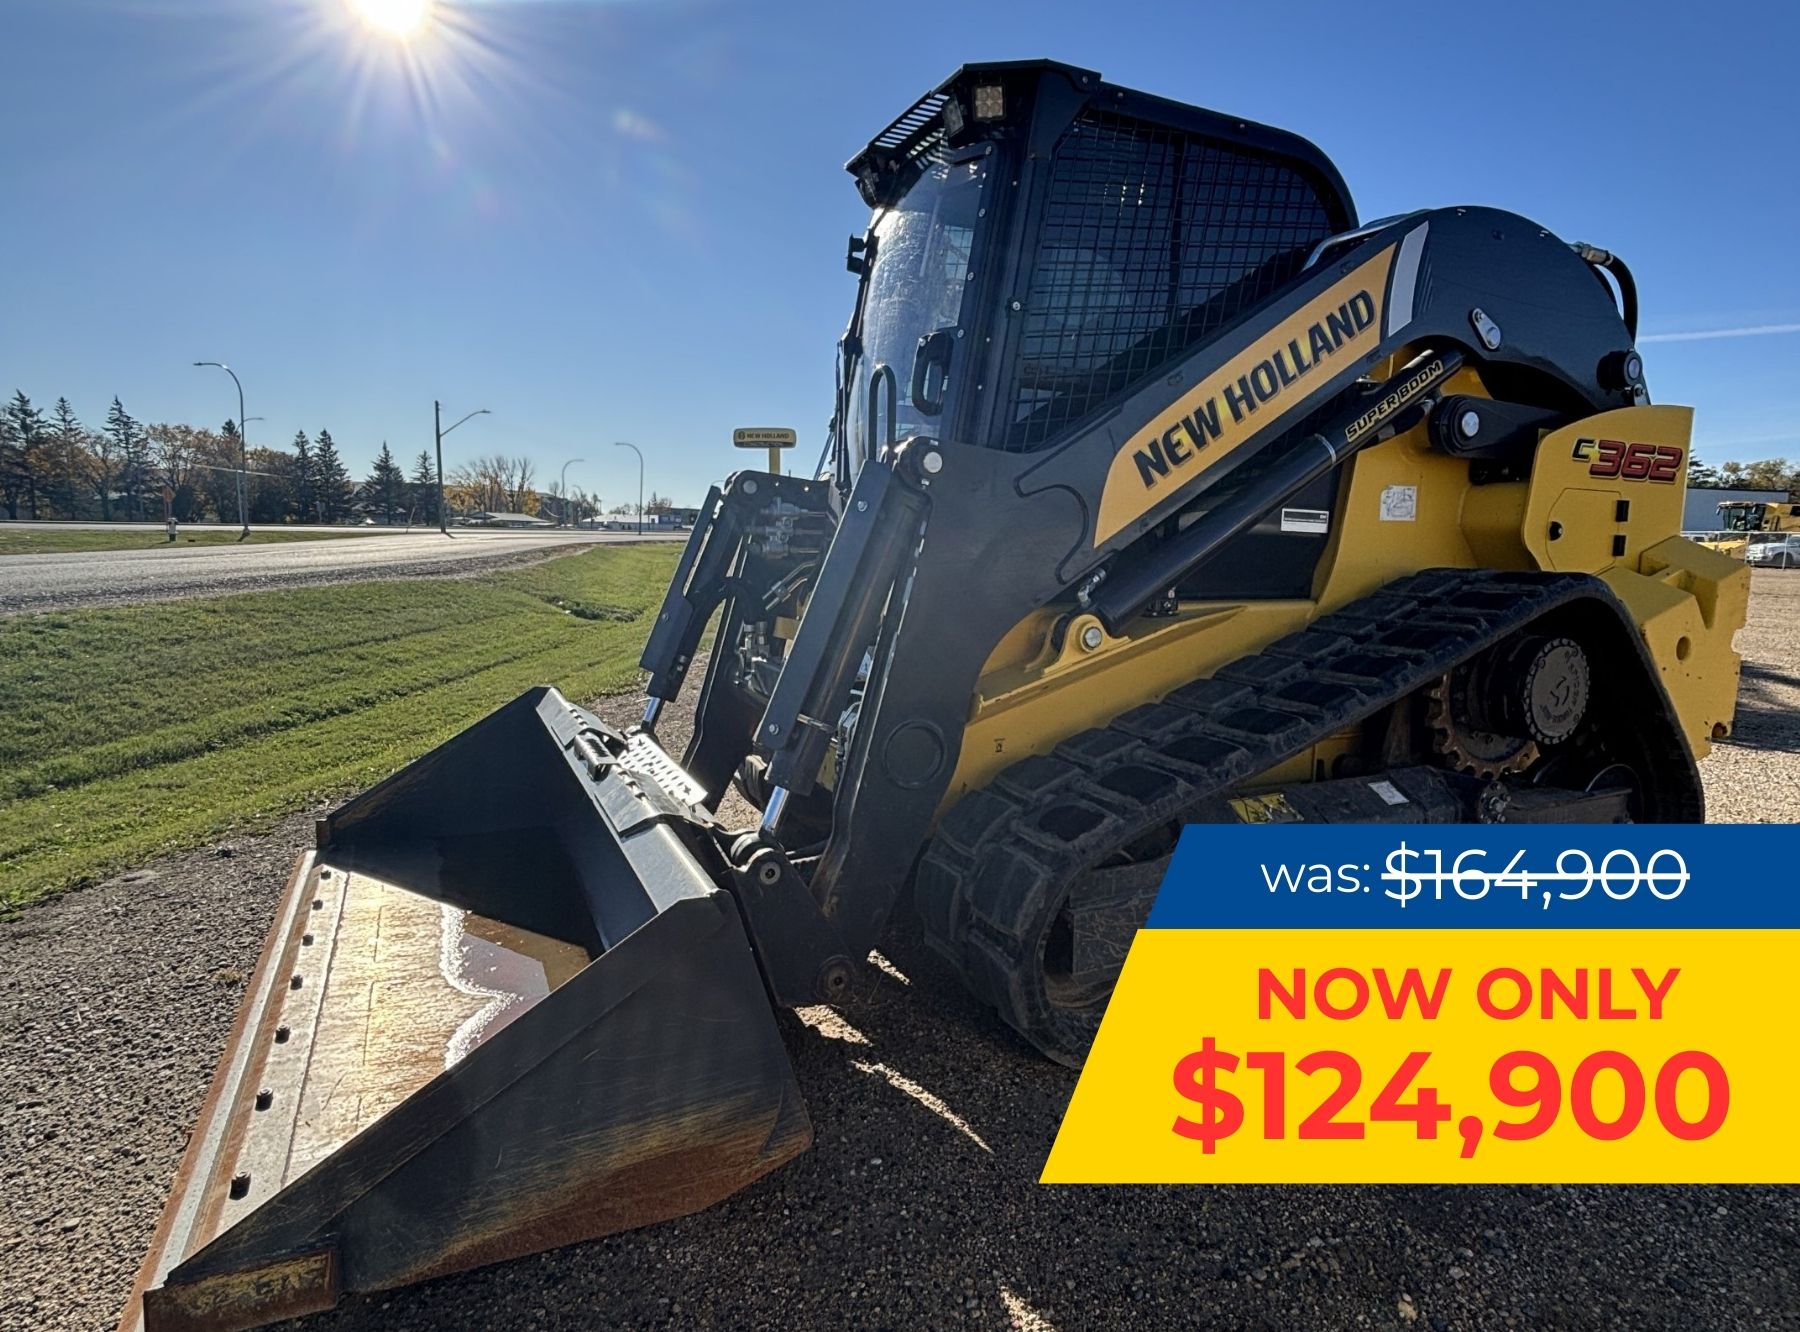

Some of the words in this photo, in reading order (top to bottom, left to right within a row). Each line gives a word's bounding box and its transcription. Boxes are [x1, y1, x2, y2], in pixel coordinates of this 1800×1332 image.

[1133, 397, 1224, 489] NEW
[1222, 289, 1377, 424] HOLLAND
[1346, 394, 1399, 442] SUPER
[1397, 360, 1444, 402] BOOM
